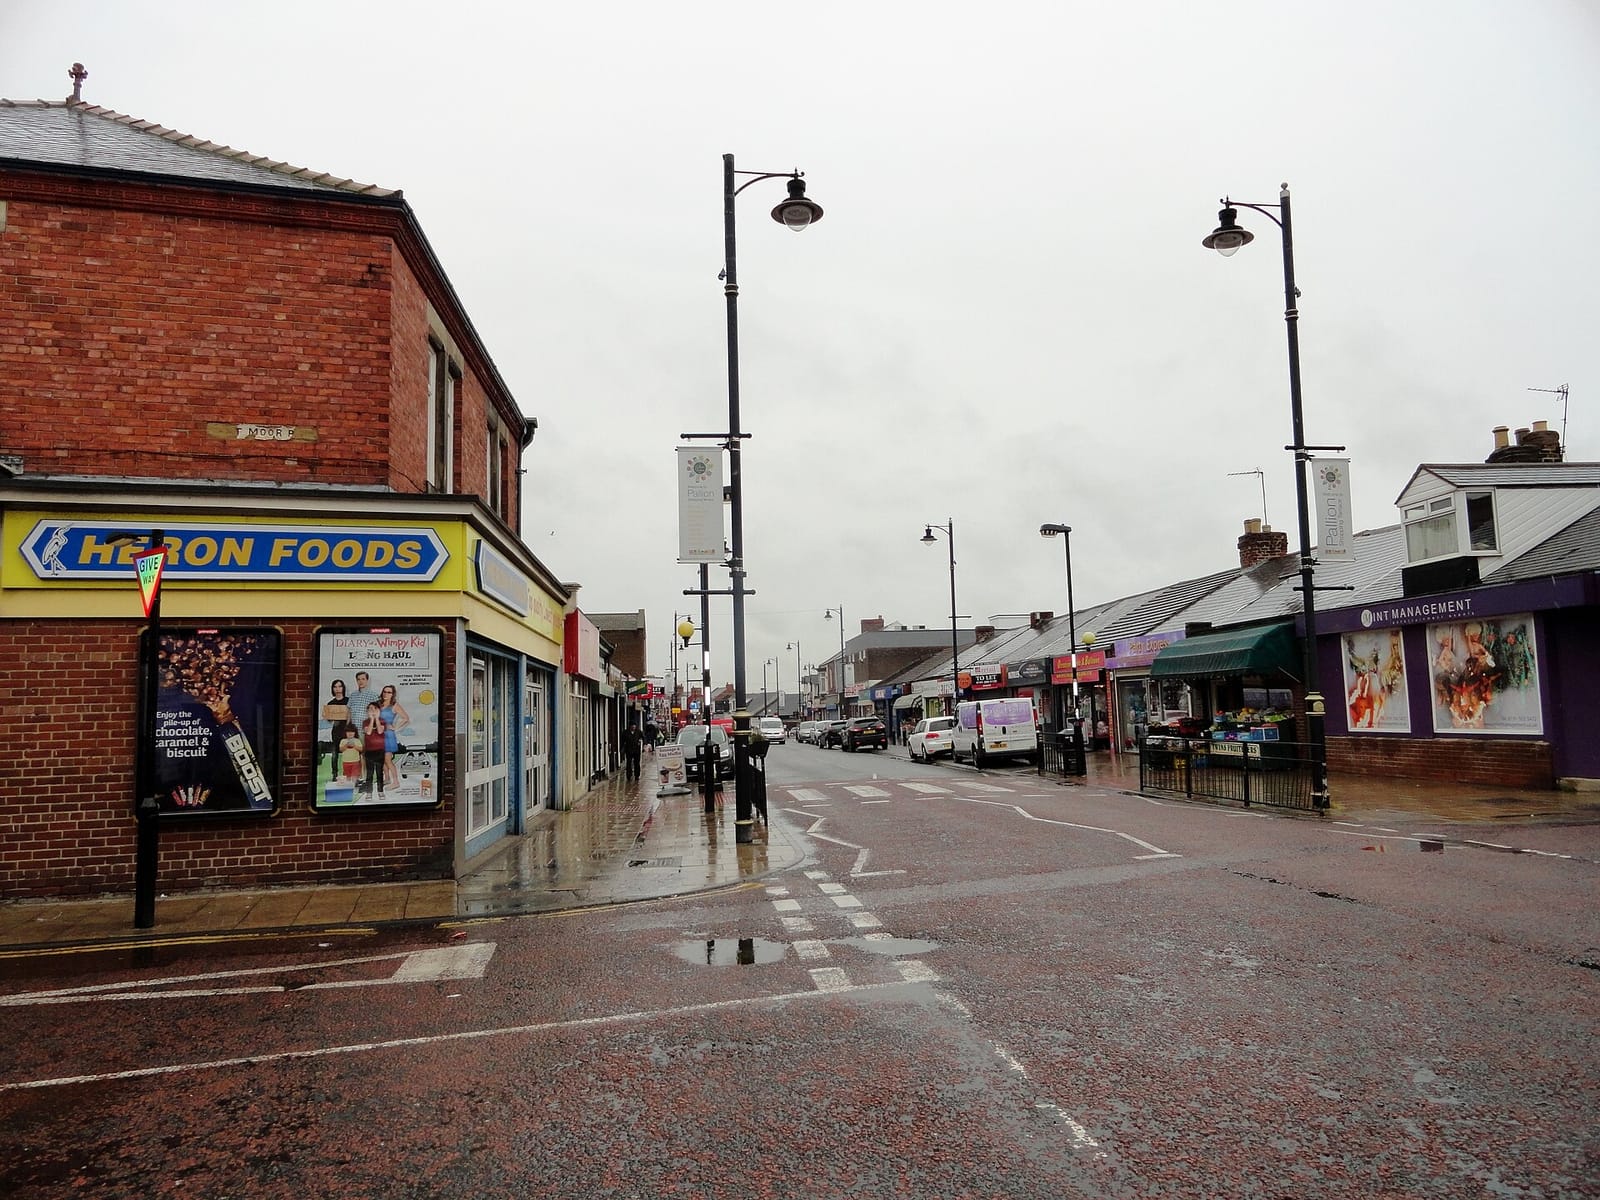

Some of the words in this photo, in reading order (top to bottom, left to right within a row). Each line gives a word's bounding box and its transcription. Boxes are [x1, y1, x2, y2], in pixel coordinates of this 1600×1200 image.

[248, 427, 282, 437] MOOR
[1325, 498, 1338, 546] Pallion
[78, 535, 255, 566] HERON
[268, 538, 423, 569] FOODS
[139, 556, 159, 573] GIVE
[142, 574, 156, 585] WAY
[1392, 598, 1471, 619] MANAGEMENT
[336, 639, 370, 648] DIARY
[376, 637, 408, 650] Wimpy
[410, 635, 426, 648] Kid
[383, 651, 411, 659] HAUL
[156, 711, 178, 720] Enjoy
[163, 719, 191, 727] pile-up
[191, 718, 200, 726] of
[155, 726, 213, 737] chocolate,
[201, 737, 209, 746] &
[167, 747, 207, 758] biscuit
[225, 733, 272, 802] BOOST
